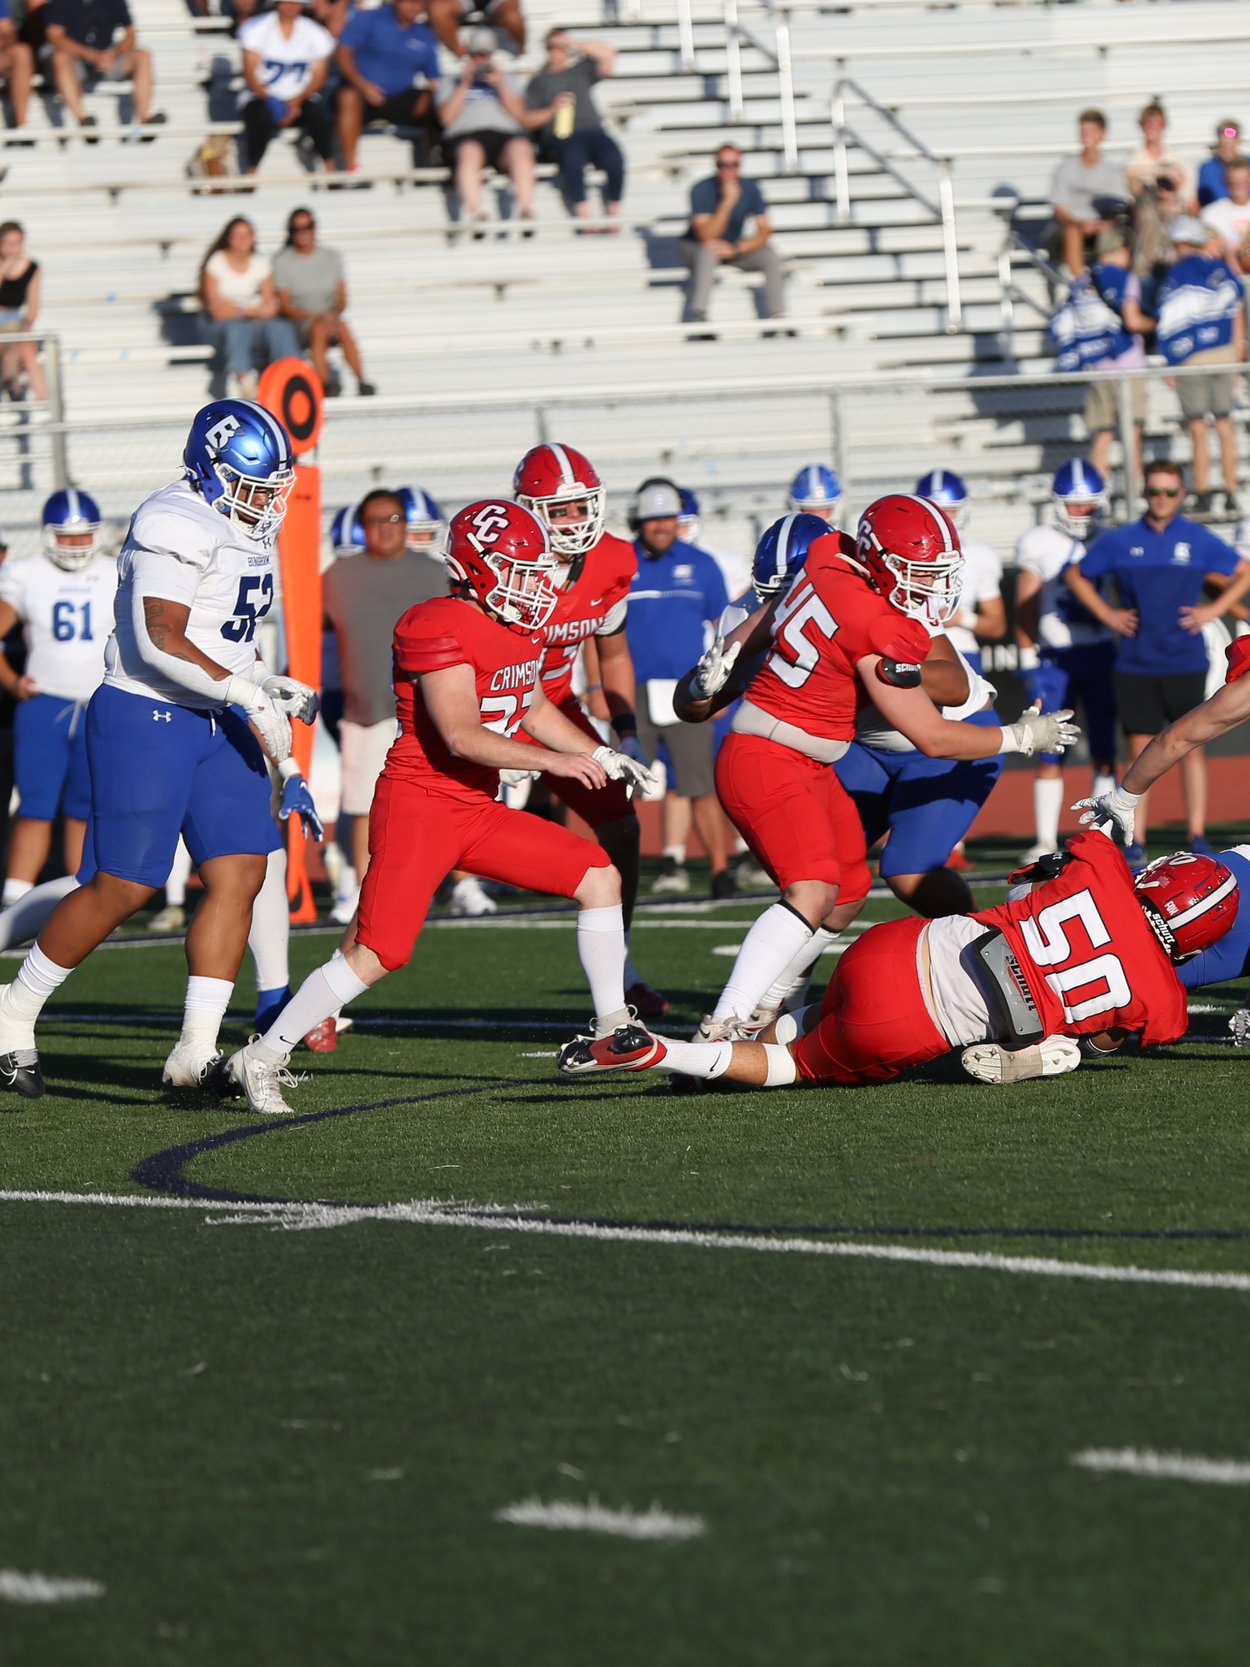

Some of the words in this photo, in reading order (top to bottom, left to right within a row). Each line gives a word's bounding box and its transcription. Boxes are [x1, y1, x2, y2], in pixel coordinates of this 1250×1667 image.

[283, 374, 317, 440] 0
[472, 505, 509, 543] CC
[53, 601, 93, 642] 61
[220, 573, 274, 643] 52
[543, 617, 604, 643] IMSON
[1152, 913, 1176, 943] schutt
[1164, 901, 1179, 916] FOX
[1018, 888, 1132, 1025] 50
